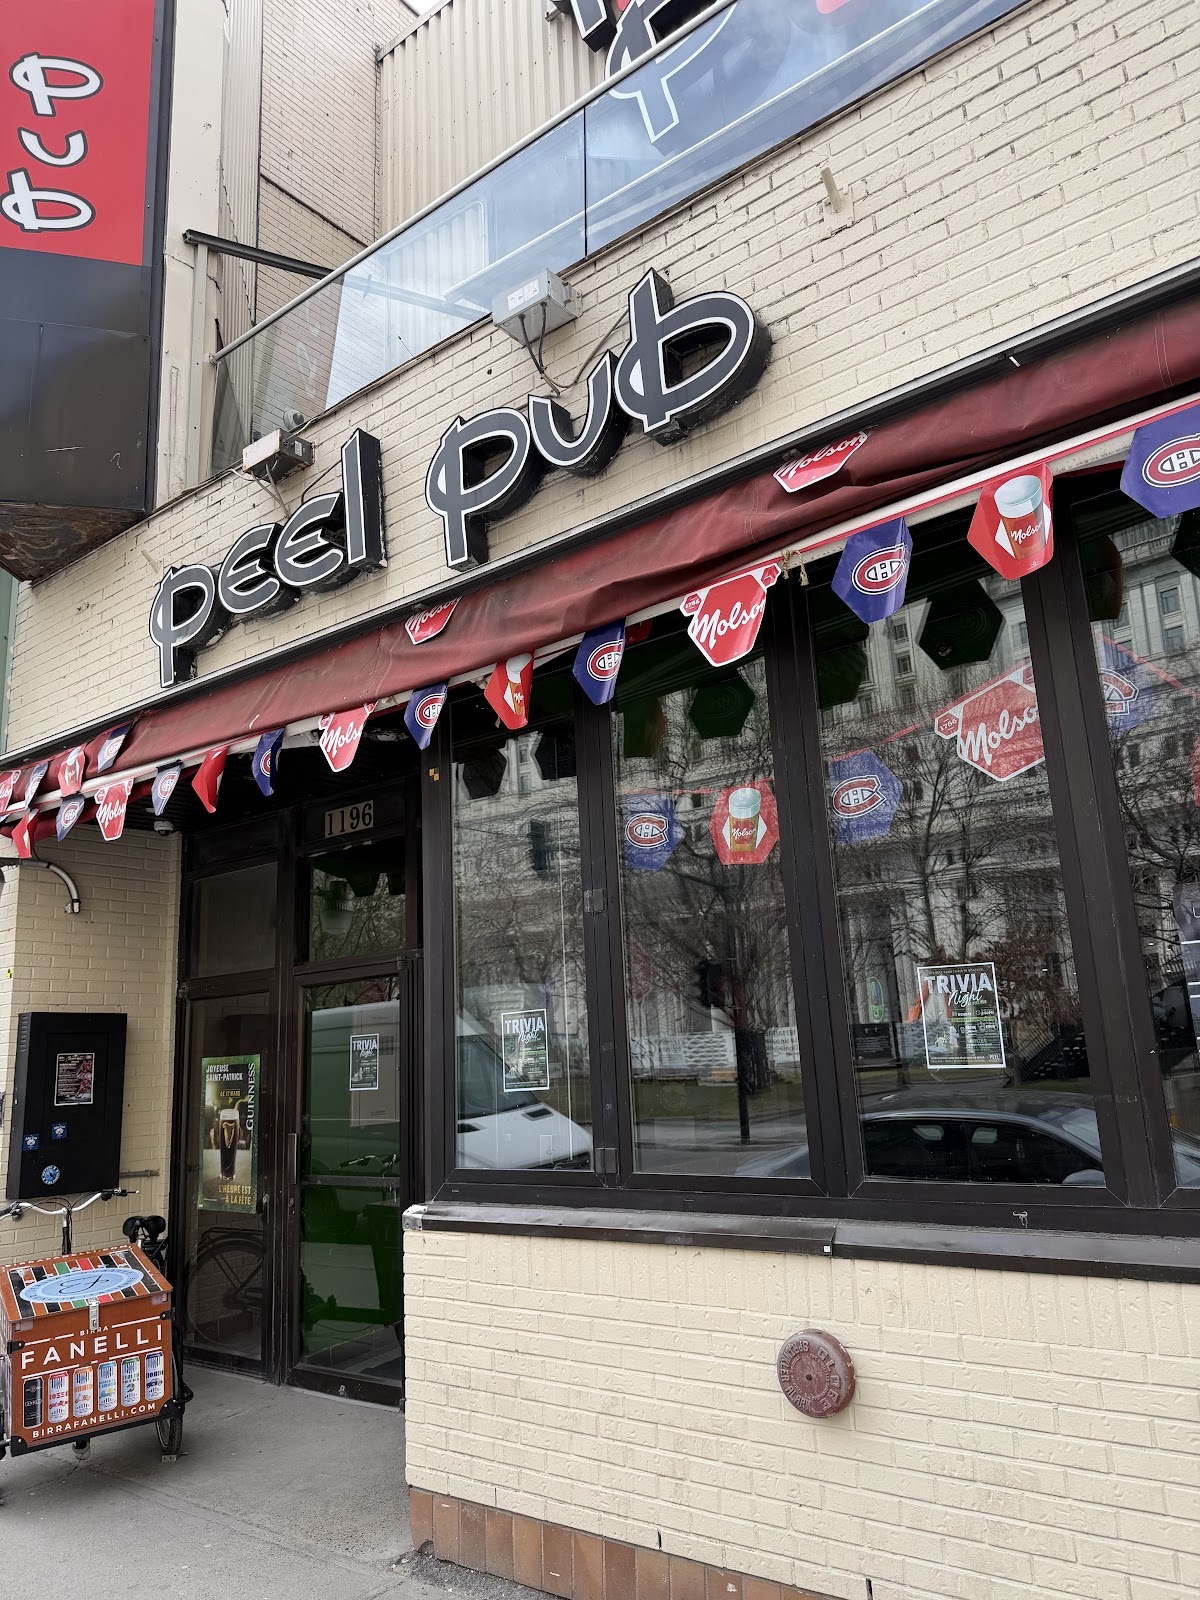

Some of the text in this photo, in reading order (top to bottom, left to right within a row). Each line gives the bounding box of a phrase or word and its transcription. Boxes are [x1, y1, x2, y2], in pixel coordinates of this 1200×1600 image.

[425, 266, 768, 568] pub
[939, 719, 958, 732] 1786
[957, 706, 1038, 766] Molso
[327, 803, 373, 836] 1196
[924, 973, 992, 995] TRIVIA
[947, 986, 984, 1008] Night
[504, 1016, 545, 1035] TRIVIA
[352, 1038, 378, 1051] TRIVIA
[205, 1064, 230, 1073] JOYEUSE
[205, 1072, 243, 1082] SAINT-PATRICK
[245, 1062, 256, 1131] GUINNESS
[230, 1195, 238, 1204] LA
[242, 1185, 252, 1194] EST
[79, 1325, 109, 1337] BIRRA
[21, 1324, 162, 1370] FANELLI
[32, 1402, 157, 1439] BIRRAFANELLI.COM
